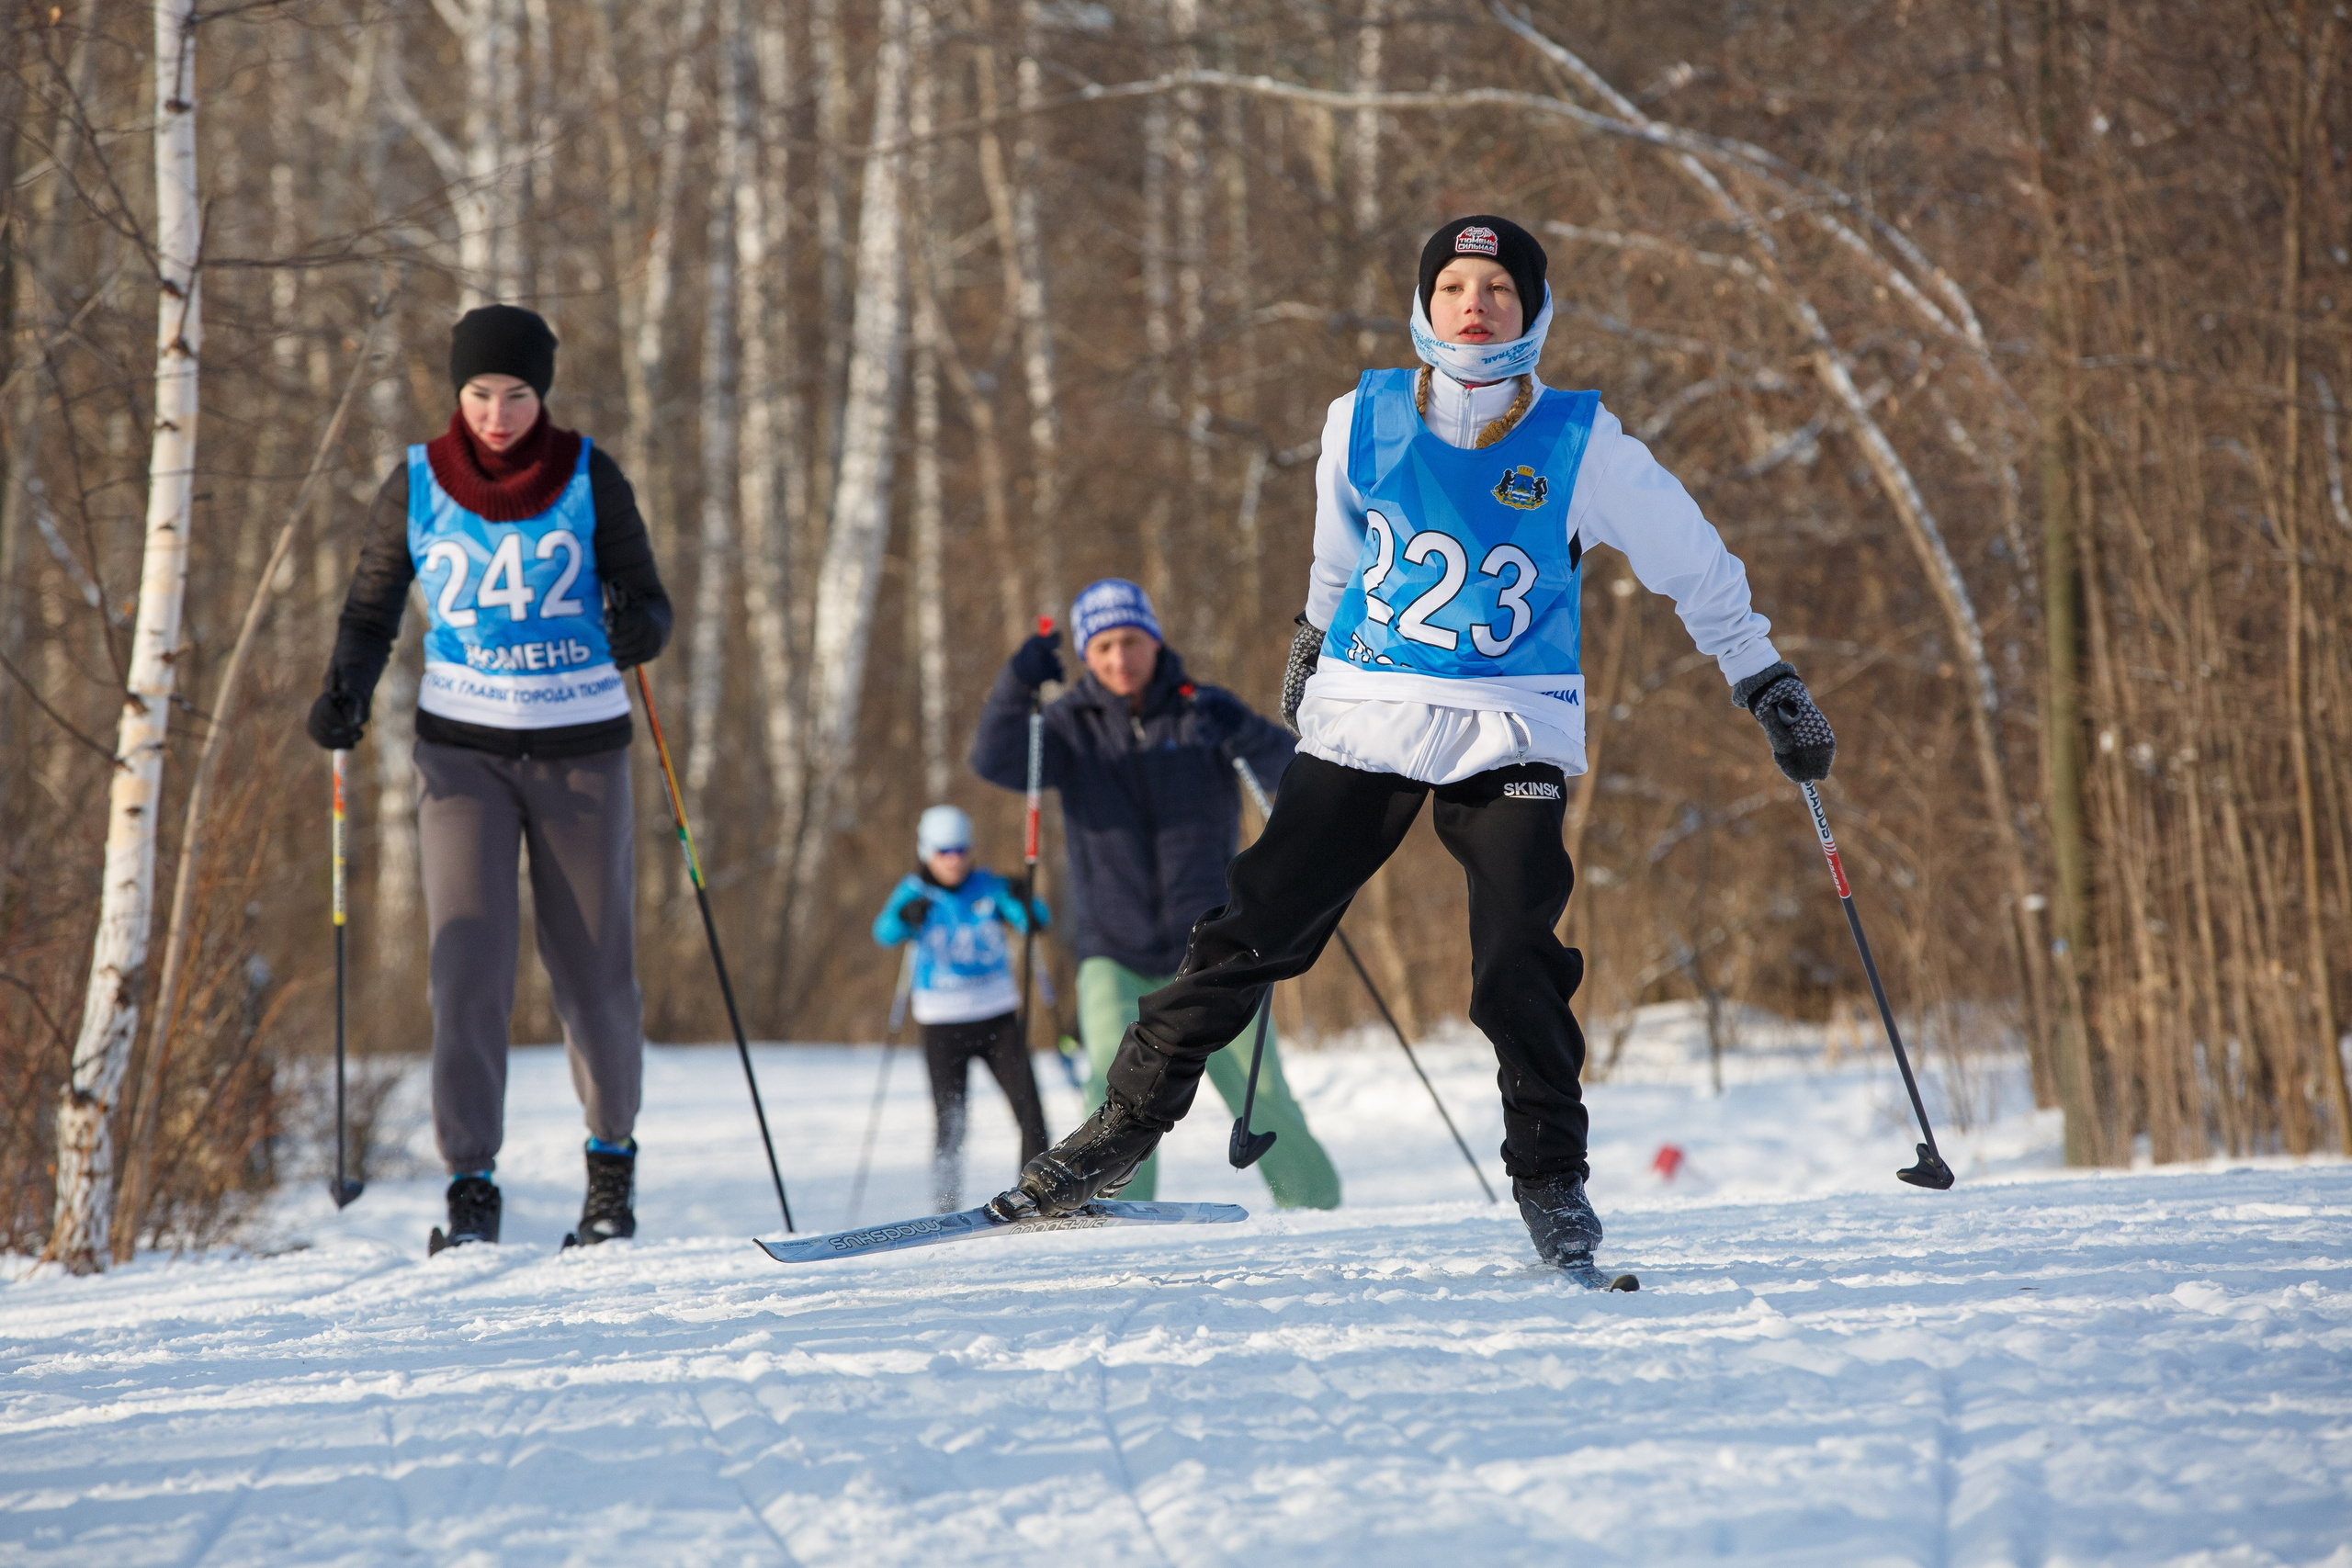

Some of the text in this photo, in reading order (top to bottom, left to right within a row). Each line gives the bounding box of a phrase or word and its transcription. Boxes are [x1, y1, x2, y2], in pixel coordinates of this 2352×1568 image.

[1458, 243, 1495, 252] СИЛЬНАЯ
[425, 529, 584, 628] 242
[1363, 508, 1540, 659] 223
[1503, 782, 1561, 799] SKINSK
